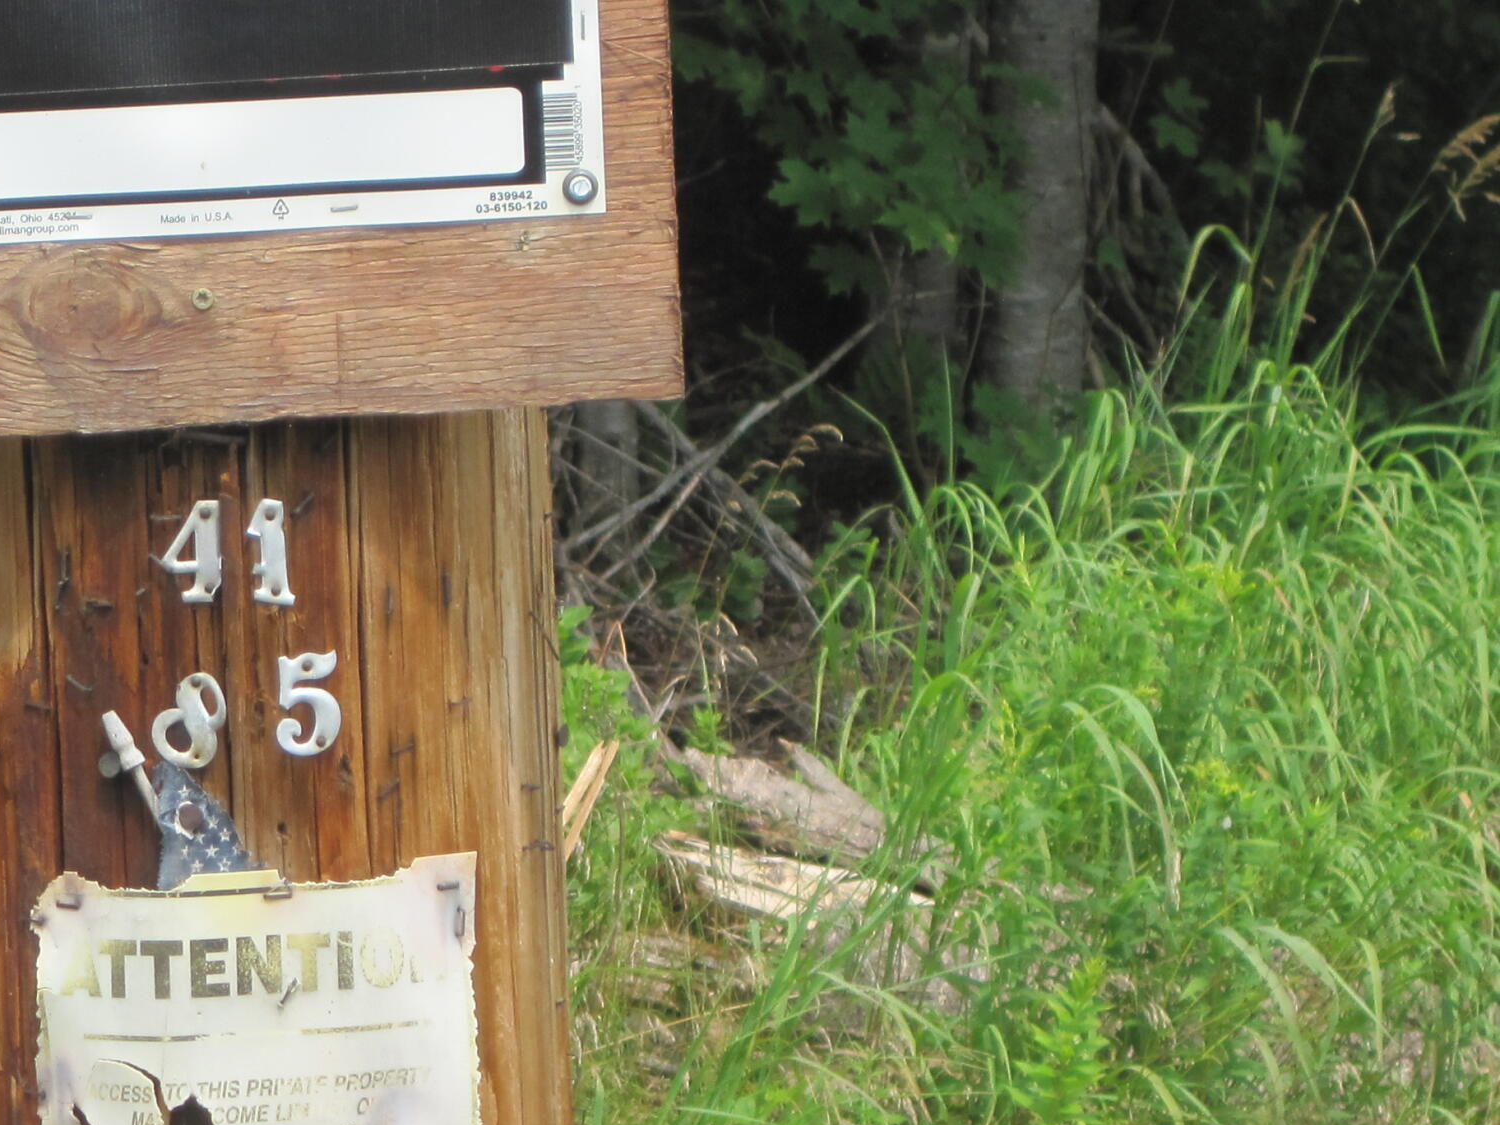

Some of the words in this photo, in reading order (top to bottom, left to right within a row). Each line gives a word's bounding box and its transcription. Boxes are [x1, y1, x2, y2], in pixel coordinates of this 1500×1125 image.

[490, 191, 533, 201] 839942
[476, 201, 548, 213] 03-6150-120
[20, 213, 42, 223] Ohio
[160, 214, 186, 224] Made
[191, 213, 199, 223] in
[160, 498, 296, 605] 41
[197, 1080, 241, 1099] THIS
